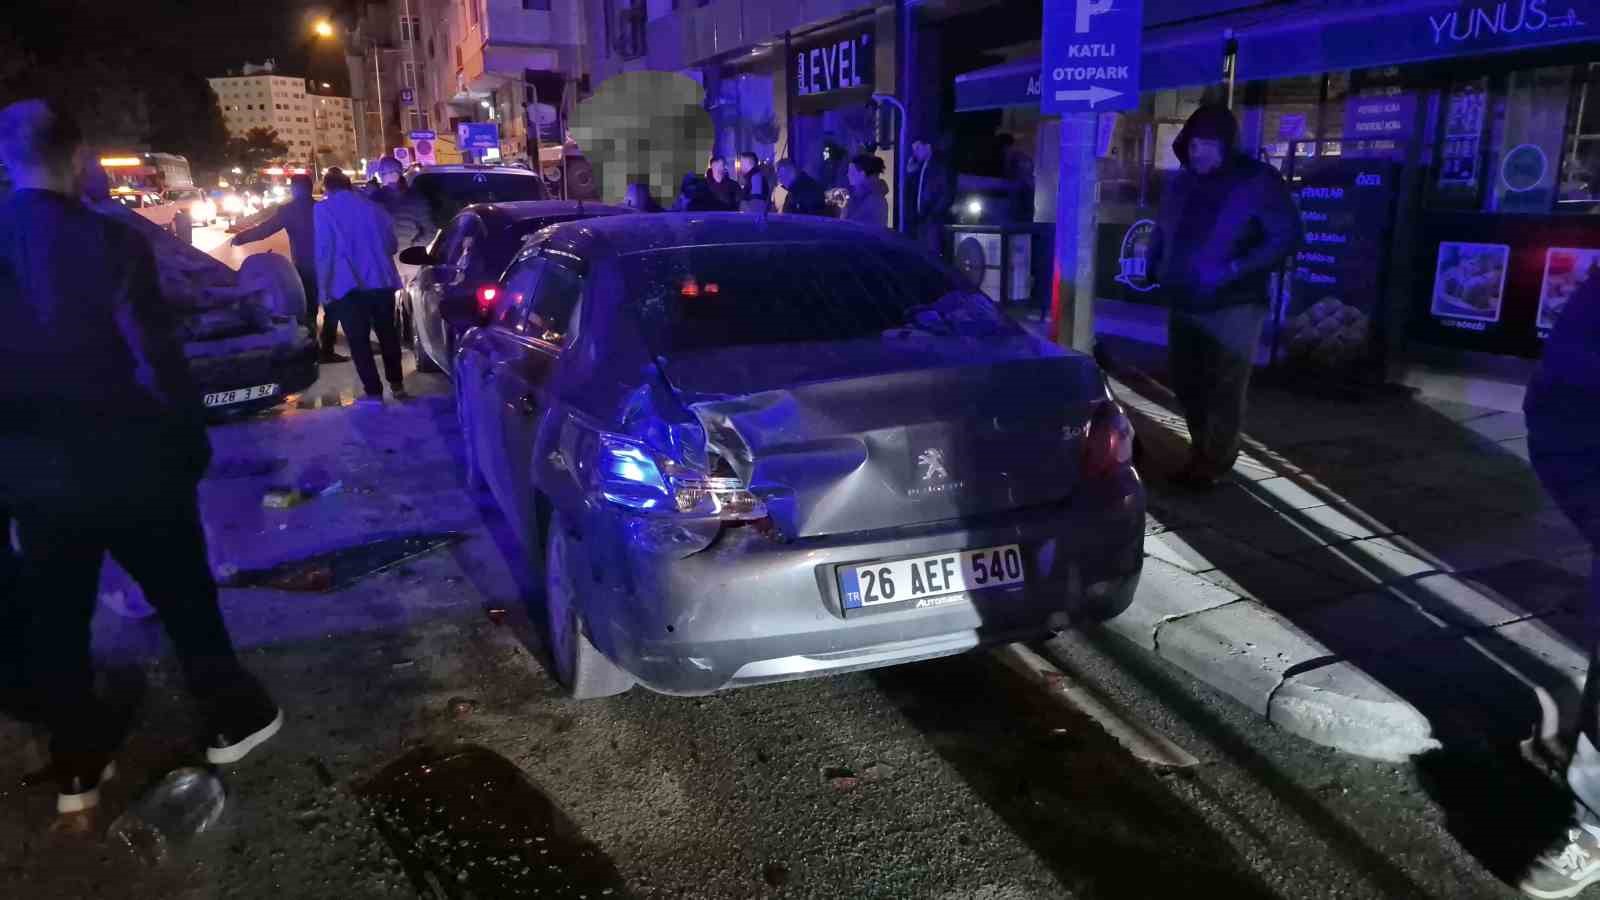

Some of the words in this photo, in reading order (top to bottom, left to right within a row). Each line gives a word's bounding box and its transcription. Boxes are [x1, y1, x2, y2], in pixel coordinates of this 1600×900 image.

[1075, 0, 1114, 33] P
[1428, 0, 1548, 45] YUNUS
[798, 39, 862, 96] LEVEL
[1068, 43, 1116, 58] KATLI
[1052, 65, 1129, 81] OTOPARK
[847, 592, 860, 602] TR
[860, 566, 895, 604] 26
[911, 557, 956, 595] AEF
[972, 549, 1021, 585] 540
